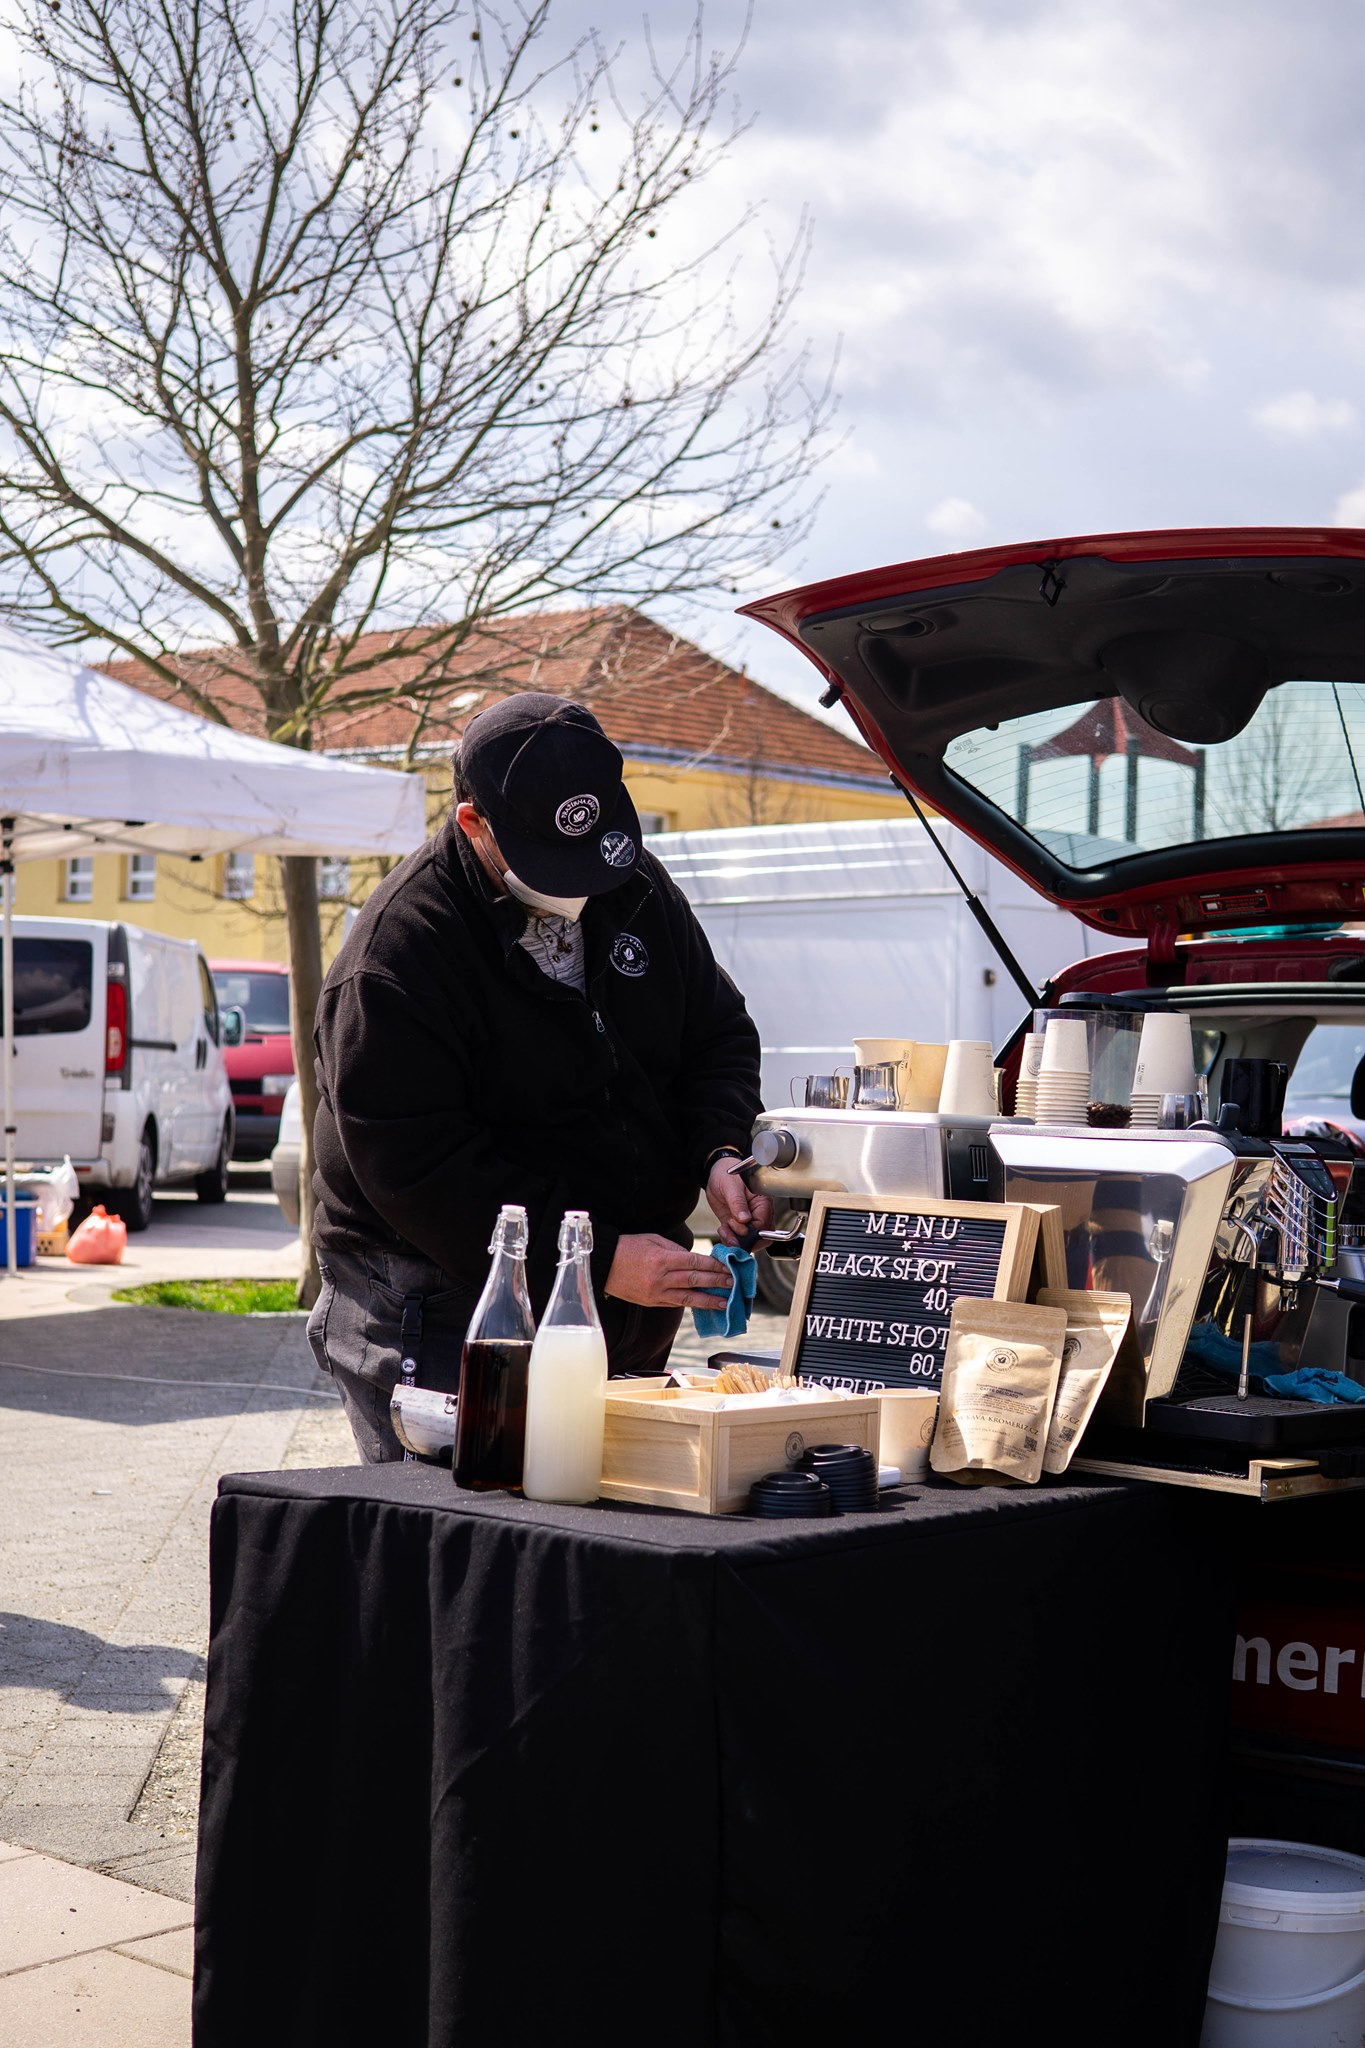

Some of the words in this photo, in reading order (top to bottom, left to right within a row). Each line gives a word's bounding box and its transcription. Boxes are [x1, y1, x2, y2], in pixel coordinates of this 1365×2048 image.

[865, 1212, 961, 1240] MENU
[815, 1251, 890, 1279] BLACK
[890, 1257, 956, 1284] SHOT
[806, 1314, 884, 1344] WHITE
[886, 1322, 950, 1351] SHOT
